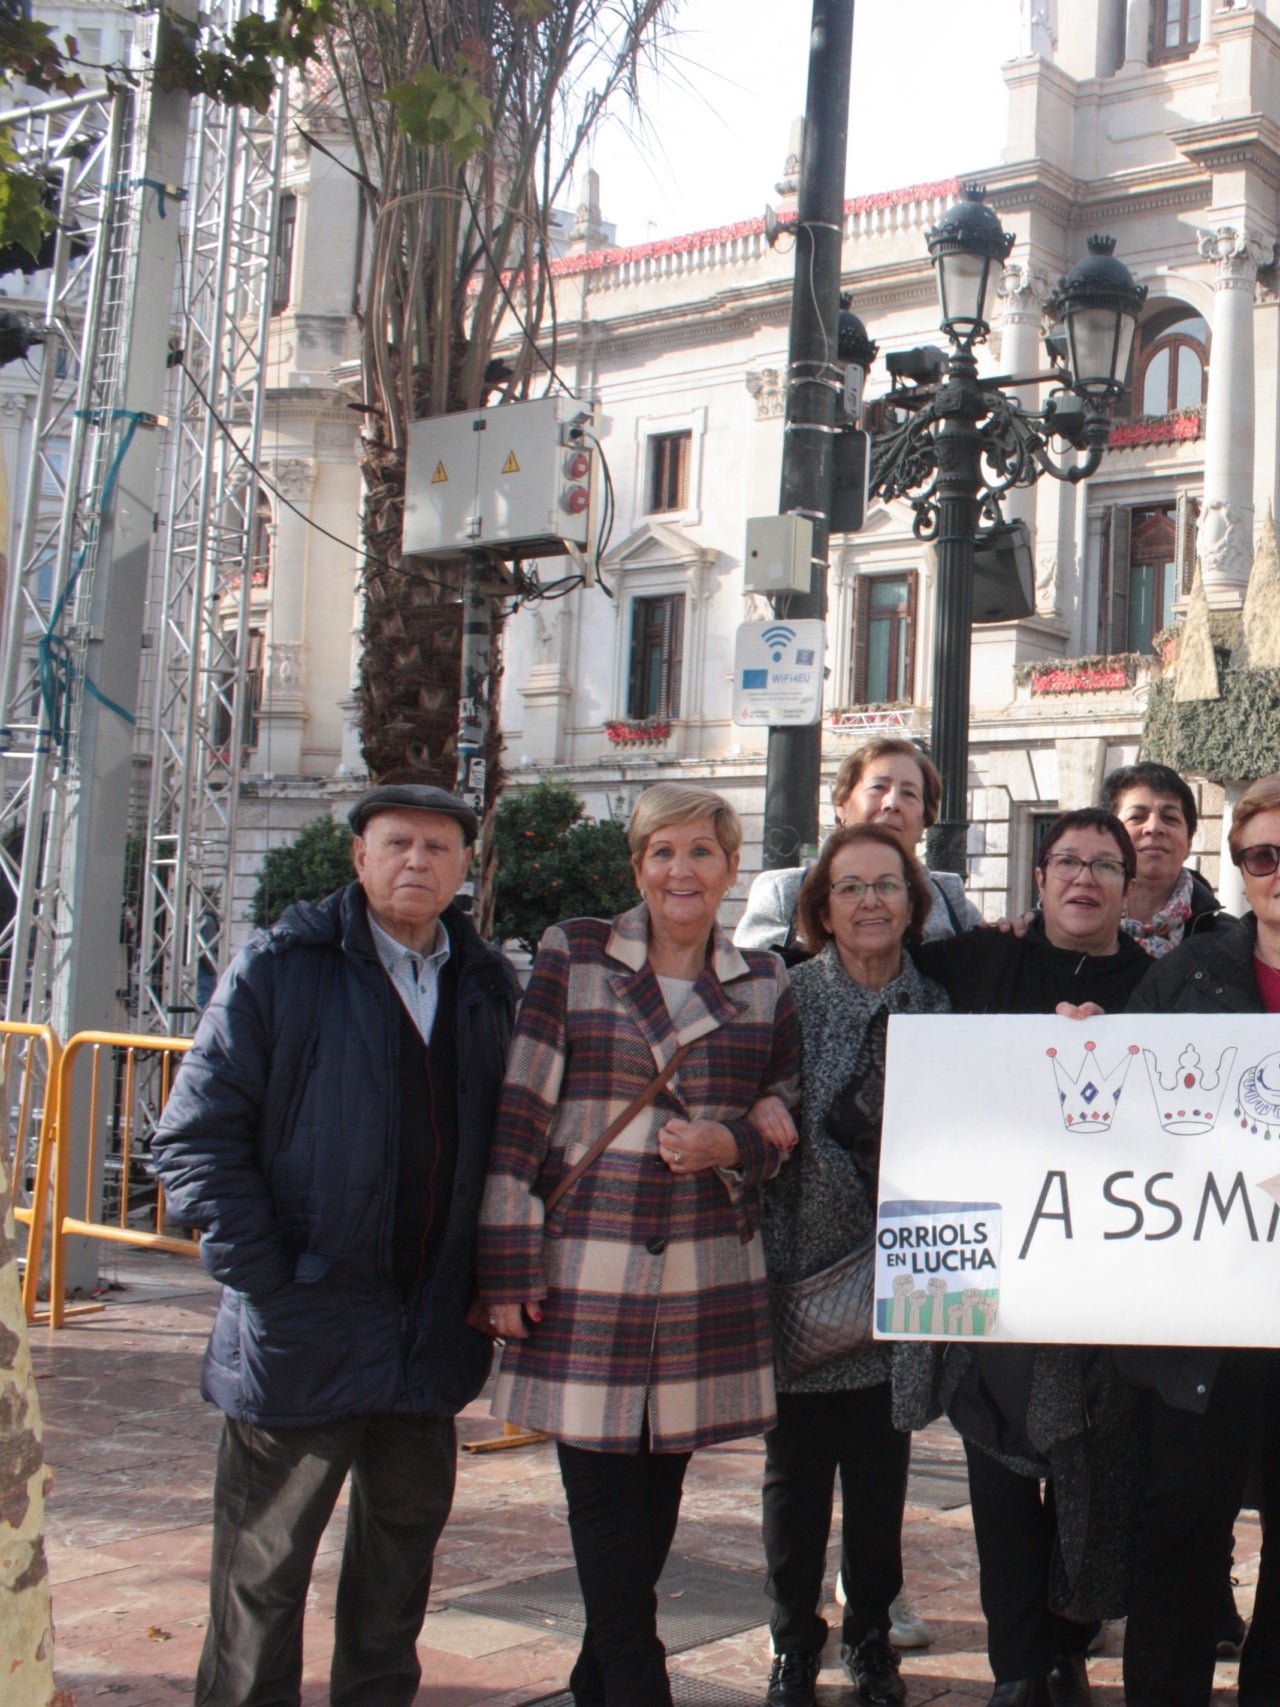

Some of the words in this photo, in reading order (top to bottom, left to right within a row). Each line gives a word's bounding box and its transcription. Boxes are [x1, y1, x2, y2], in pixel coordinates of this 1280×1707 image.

[878, 1222, 988, 1250] ORRIOLS
[887, 1252, 907, 1267] EN
[912, 1247, 997, 1274] LUCHA
